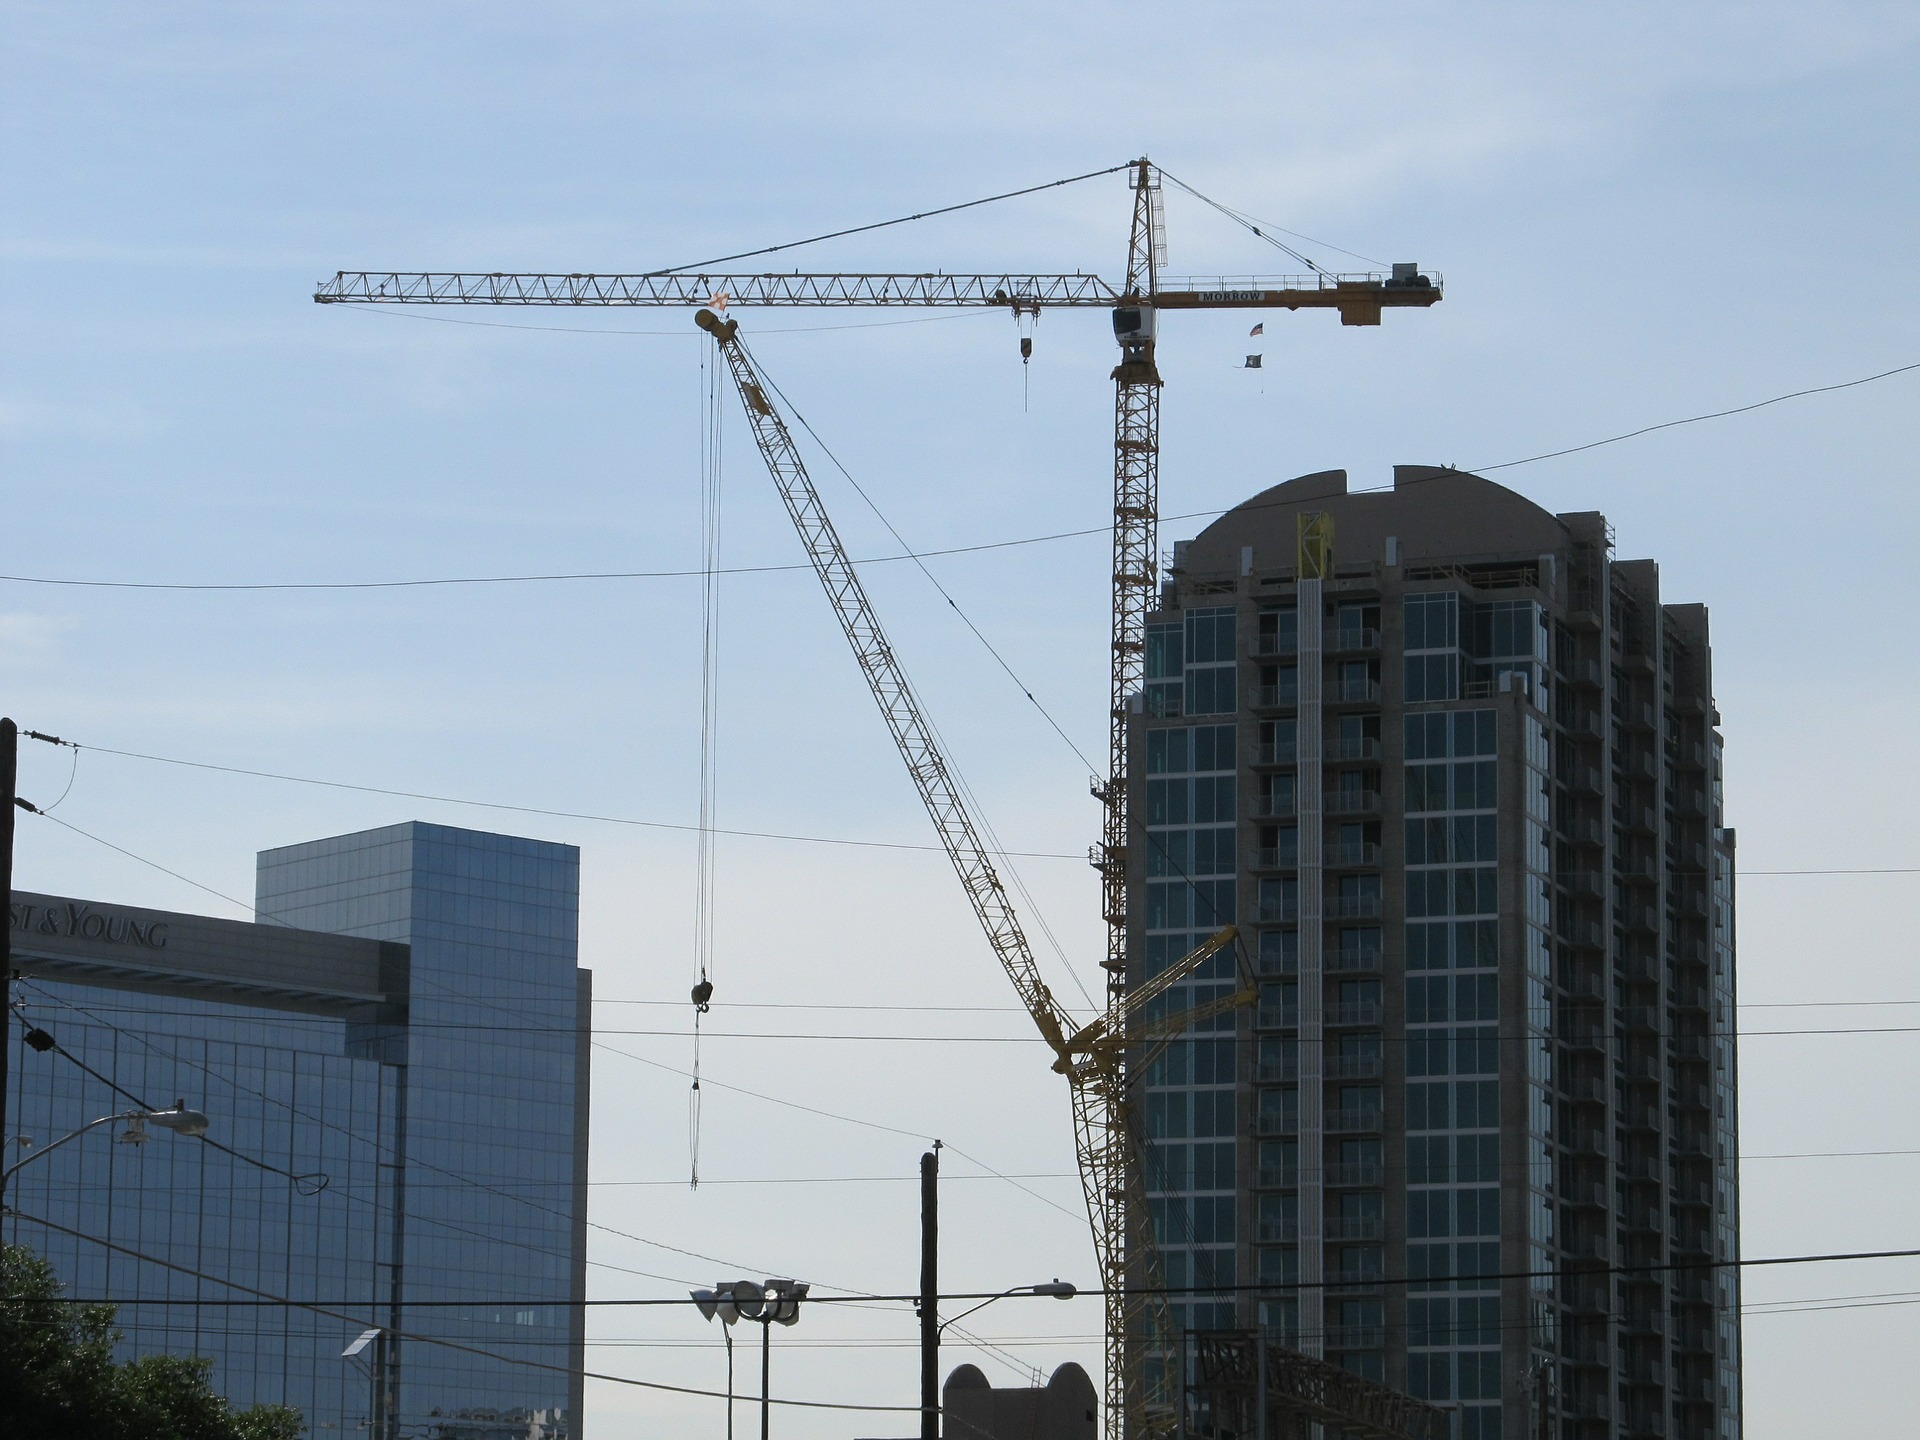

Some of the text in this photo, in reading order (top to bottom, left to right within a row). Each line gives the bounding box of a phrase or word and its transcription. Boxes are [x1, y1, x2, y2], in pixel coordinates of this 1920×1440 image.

[1203, 292, 1261, 301] MORROW
[38, 907, 59, 934] &
[66, 902, 169, 948] YOUNG
